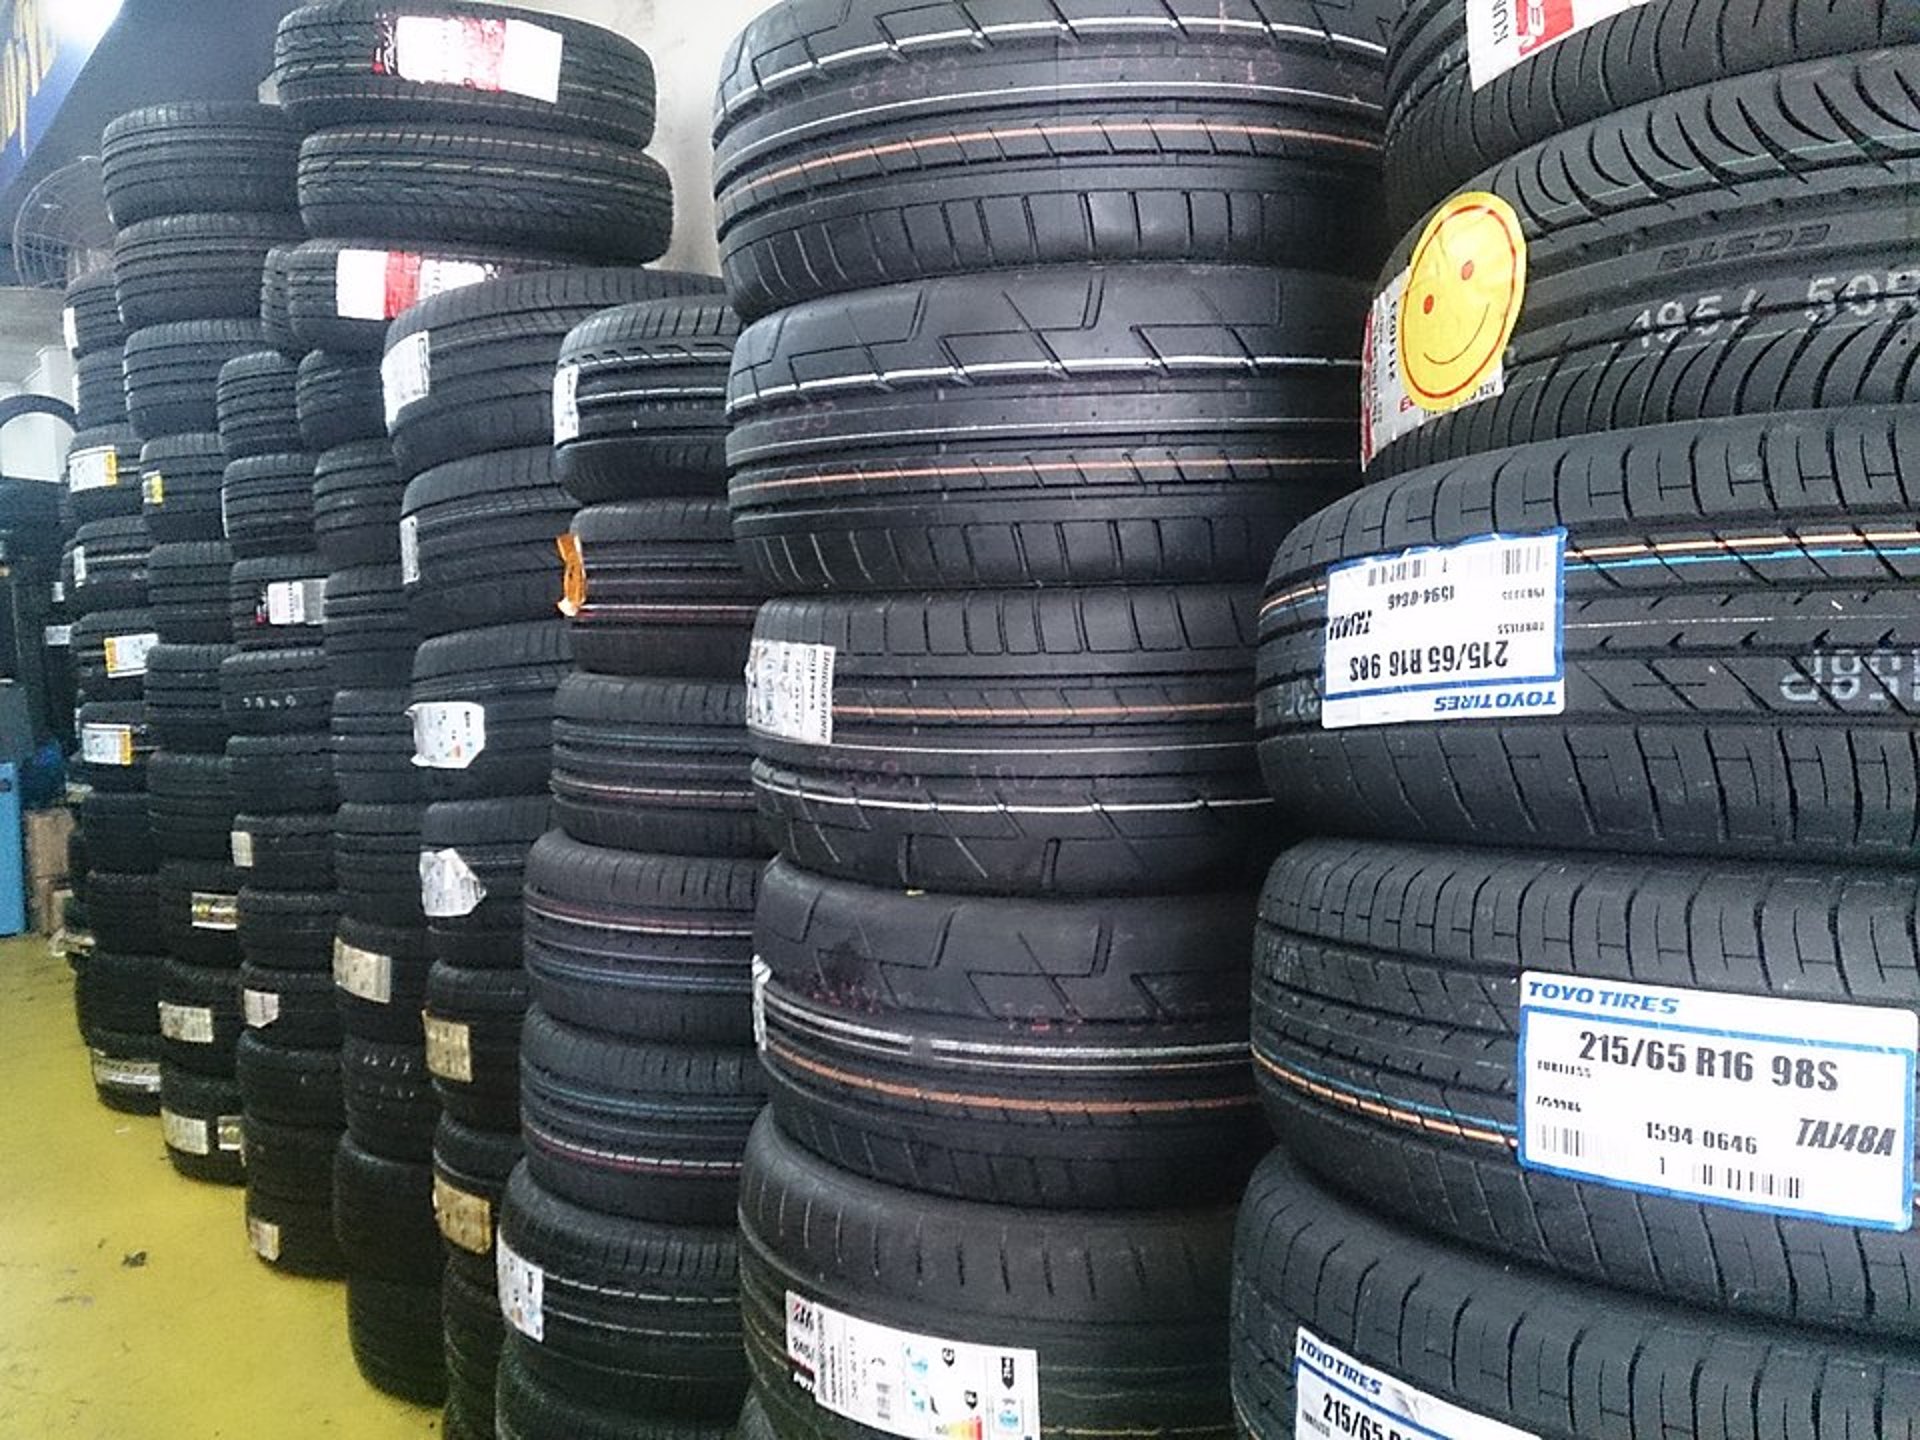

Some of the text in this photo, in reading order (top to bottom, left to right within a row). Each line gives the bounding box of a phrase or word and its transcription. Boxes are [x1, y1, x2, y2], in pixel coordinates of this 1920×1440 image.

[1349, 639, 1509, 682] 215/65 R16 98S
[1433, 690, 1557, 712] TOYO TIRES
[1528, 981, 1680, 1015] TOYO TIRES
[1578, 1030, 1839, 1092] 215/65 R16 98S
[1795, 1117, 1897, 1157] TAJ48A
[1300, 1336, 1384, 1396] TOYO TIRES
